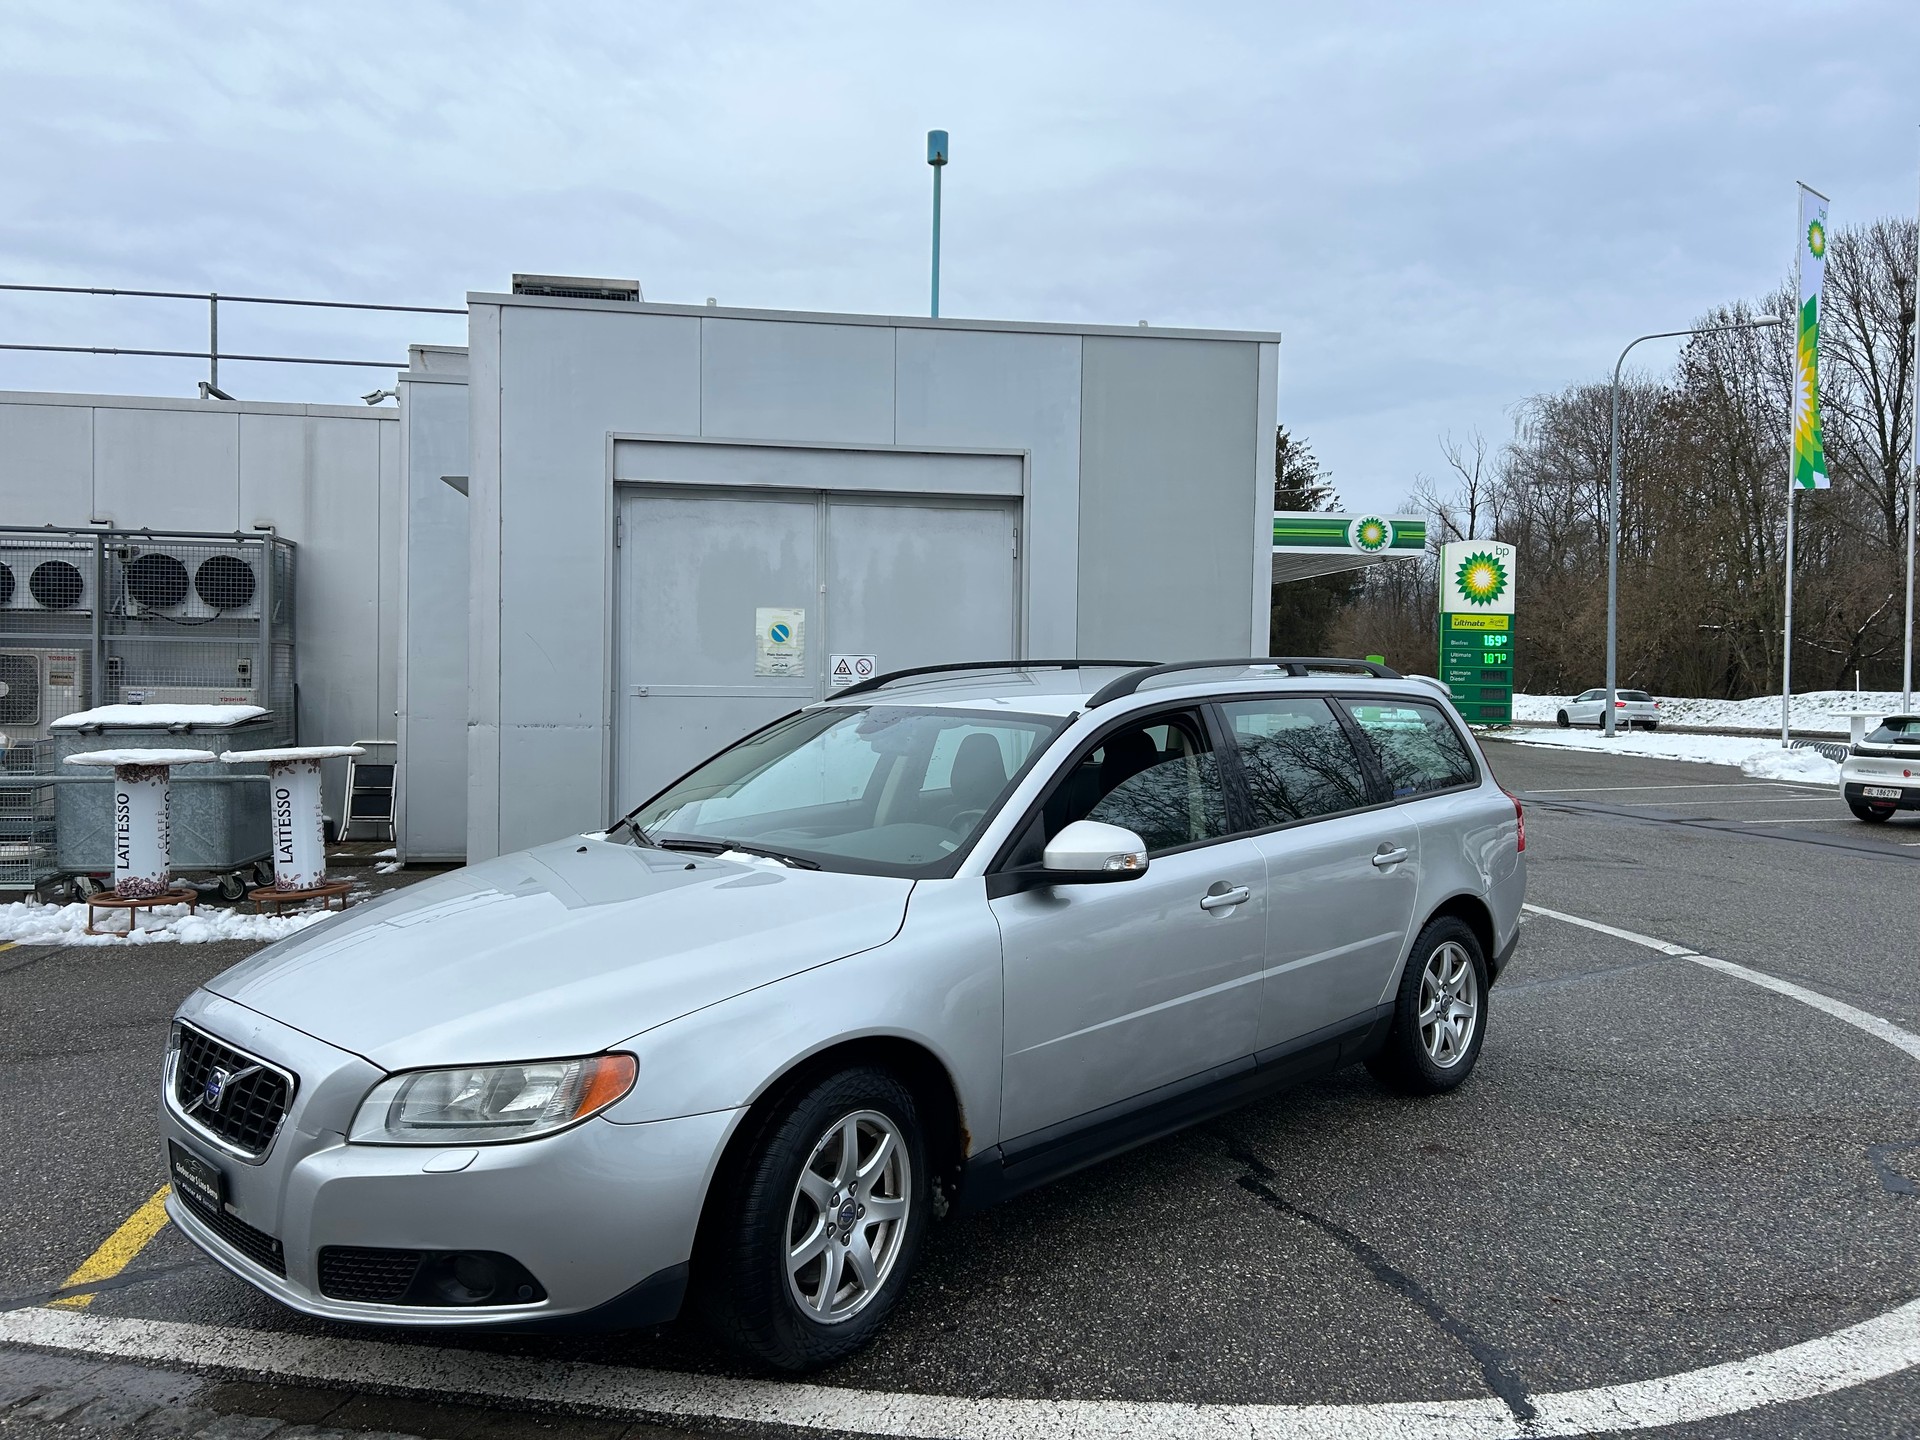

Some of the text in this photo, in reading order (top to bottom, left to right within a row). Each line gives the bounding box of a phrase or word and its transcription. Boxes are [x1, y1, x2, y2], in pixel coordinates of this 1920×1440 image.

[1818, 205, 1827, 220] bp
[1495, 545, 1510, 558] bp
[116, 792, 130, 870] LATTESSO
[275, 788, 294, 864] LATTESSO
